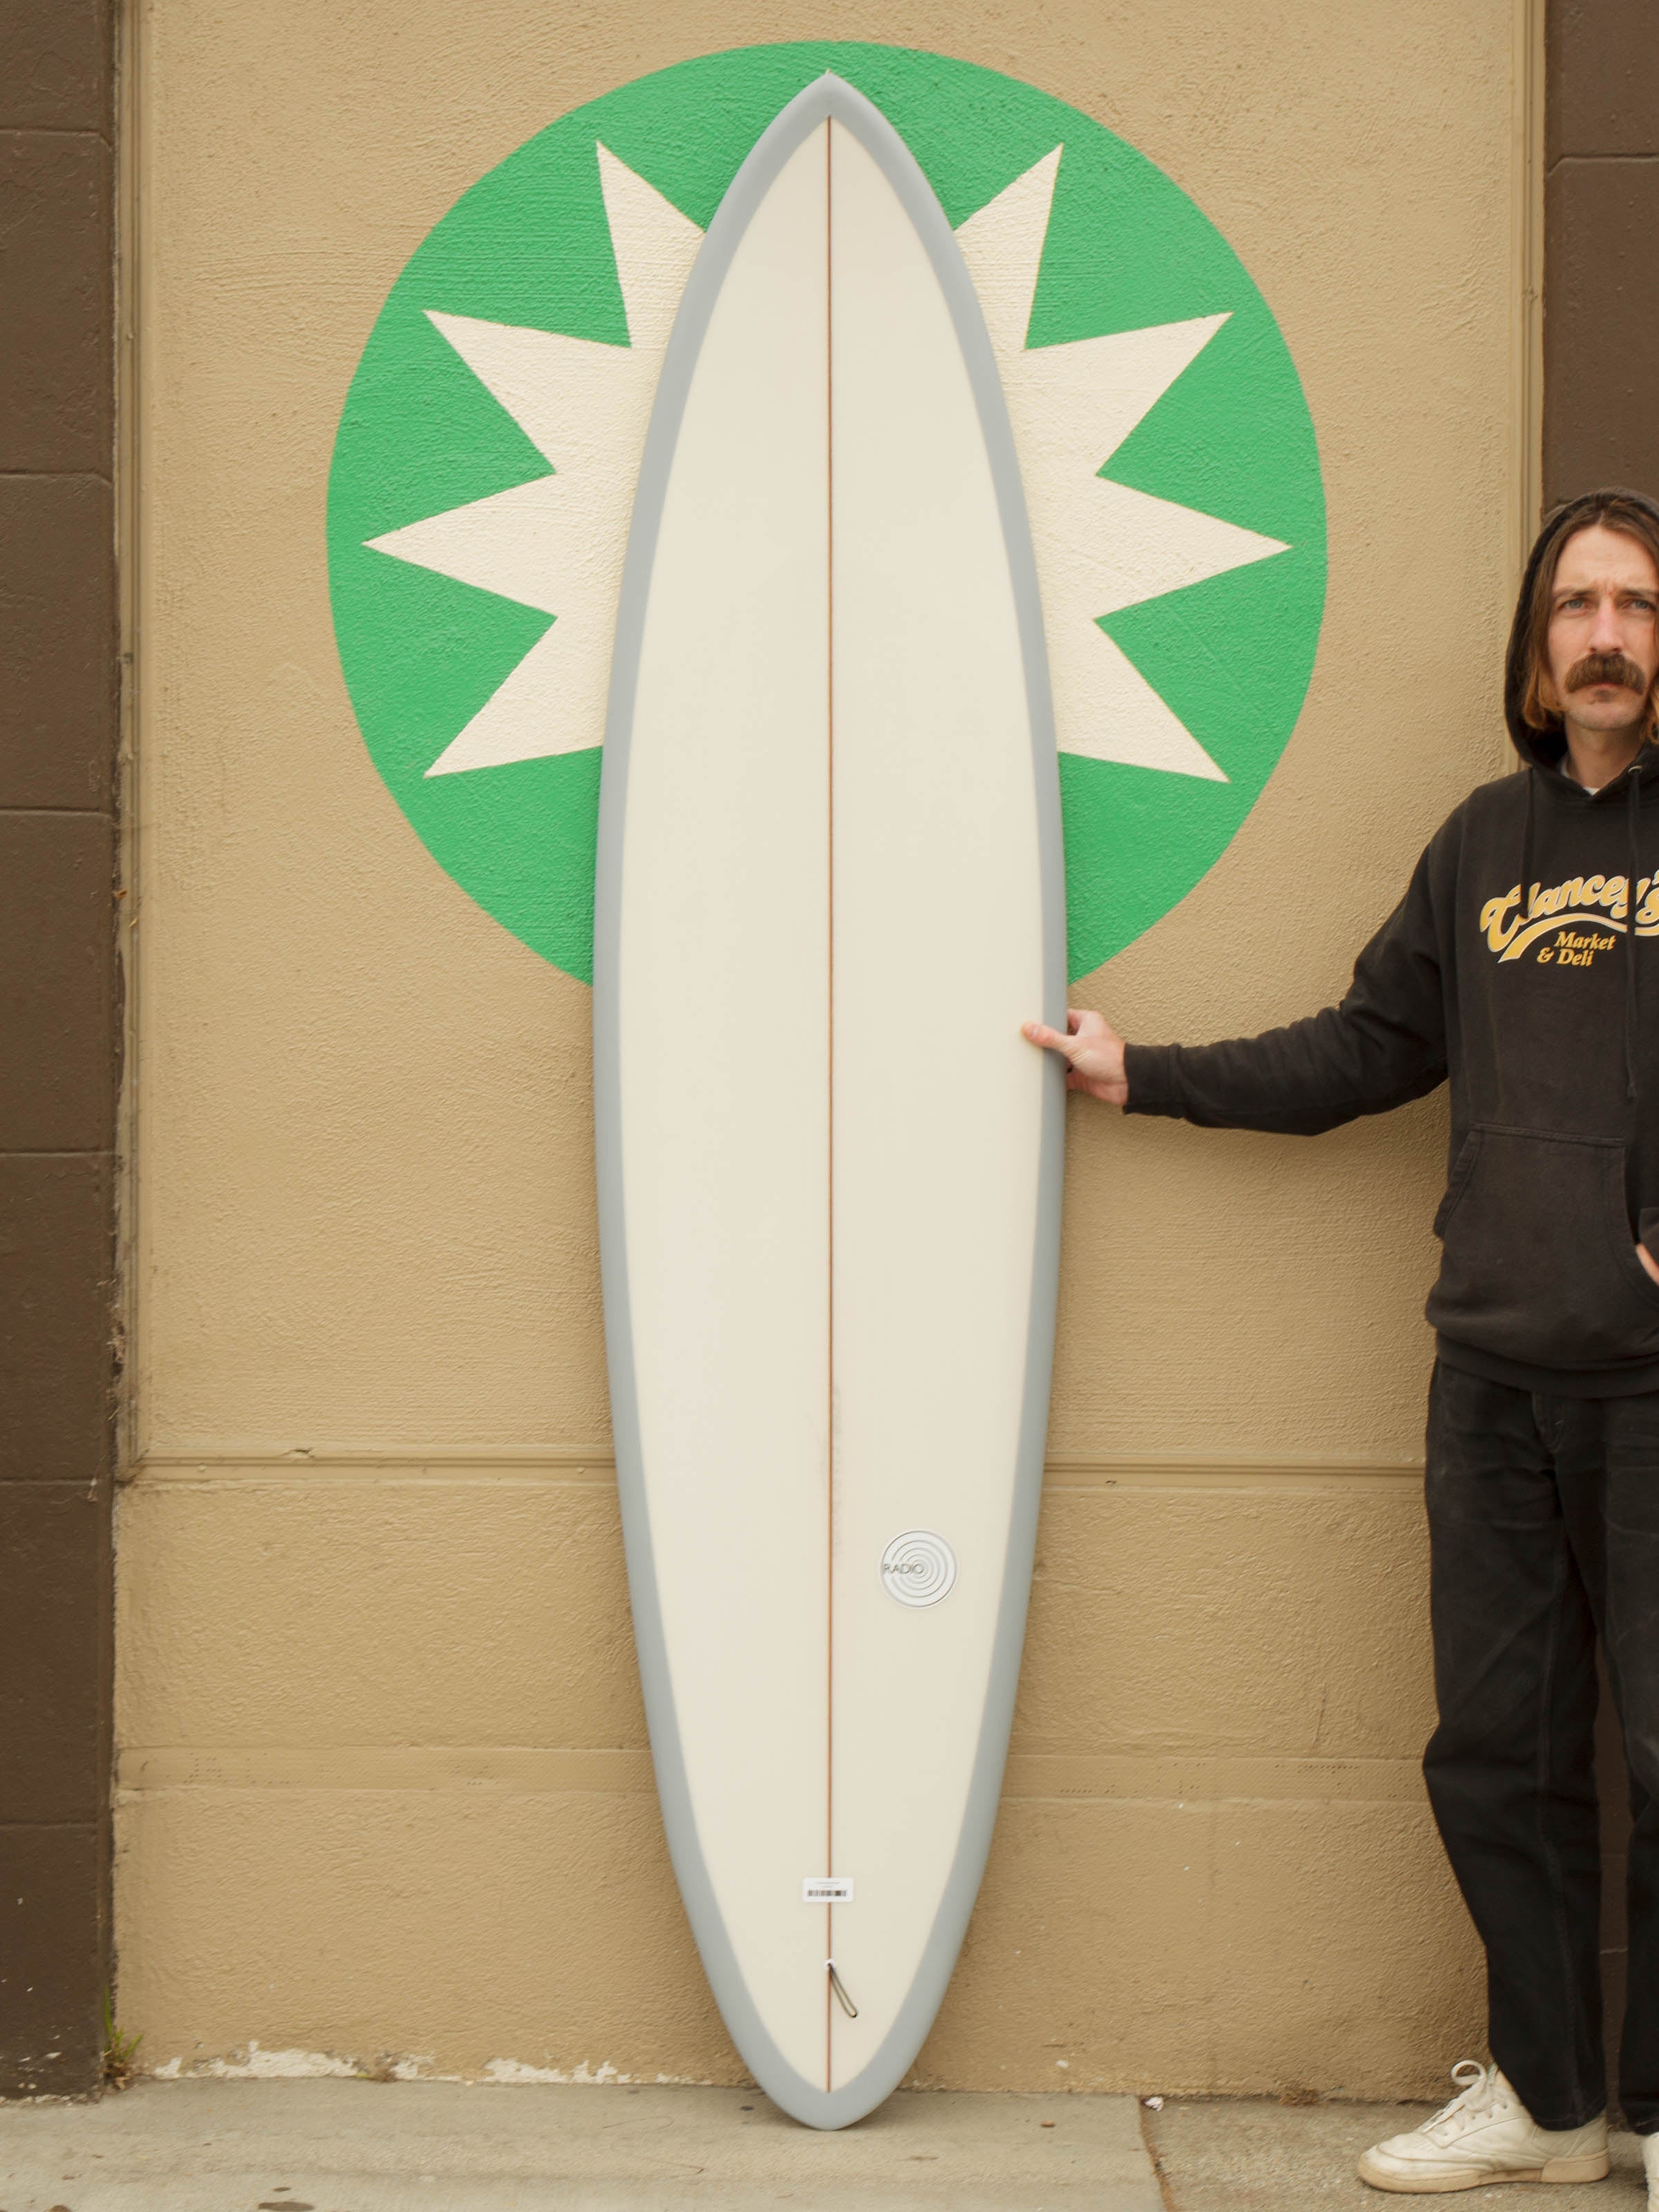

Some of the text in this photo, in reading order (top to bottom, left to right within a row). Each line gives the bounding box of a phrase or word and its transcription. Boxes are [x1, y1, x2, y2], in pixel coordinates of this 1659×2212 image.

[1554, 931, 1617, 951] Market
[1537, 947, 1595, 967] & Deli
[882, 1563, 925, 1575] RADIO
